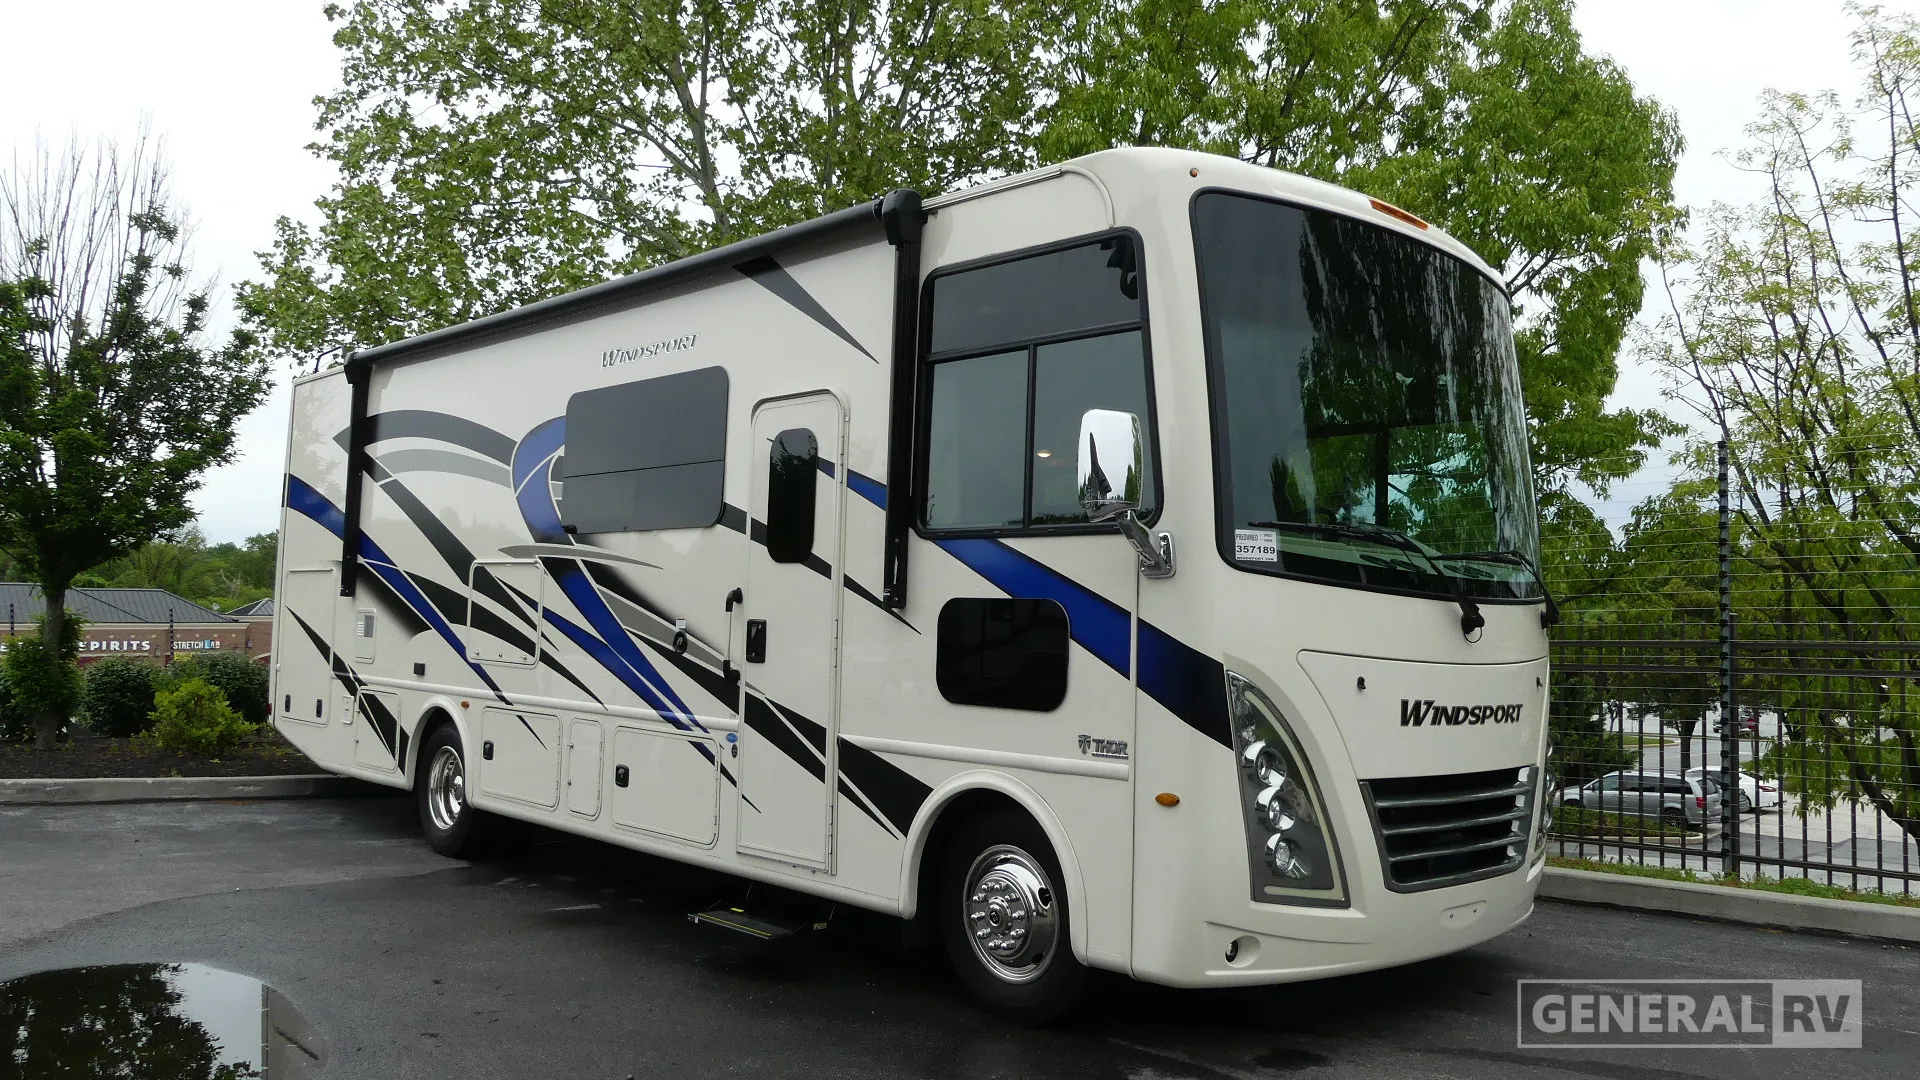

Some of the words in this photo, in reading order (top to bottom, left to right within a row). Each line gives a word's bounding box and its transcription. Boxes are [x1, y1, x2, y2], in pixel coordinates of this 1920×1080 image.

[602, 333, 699, 368] WINDSPORT
[1236, 545, 1276, 554] 357189
[78, 640, 151, 652] SPIRITS
[1400, 699, 1523, 727] WINDSPORT
[1092, 738, 1129, 756] THOR
